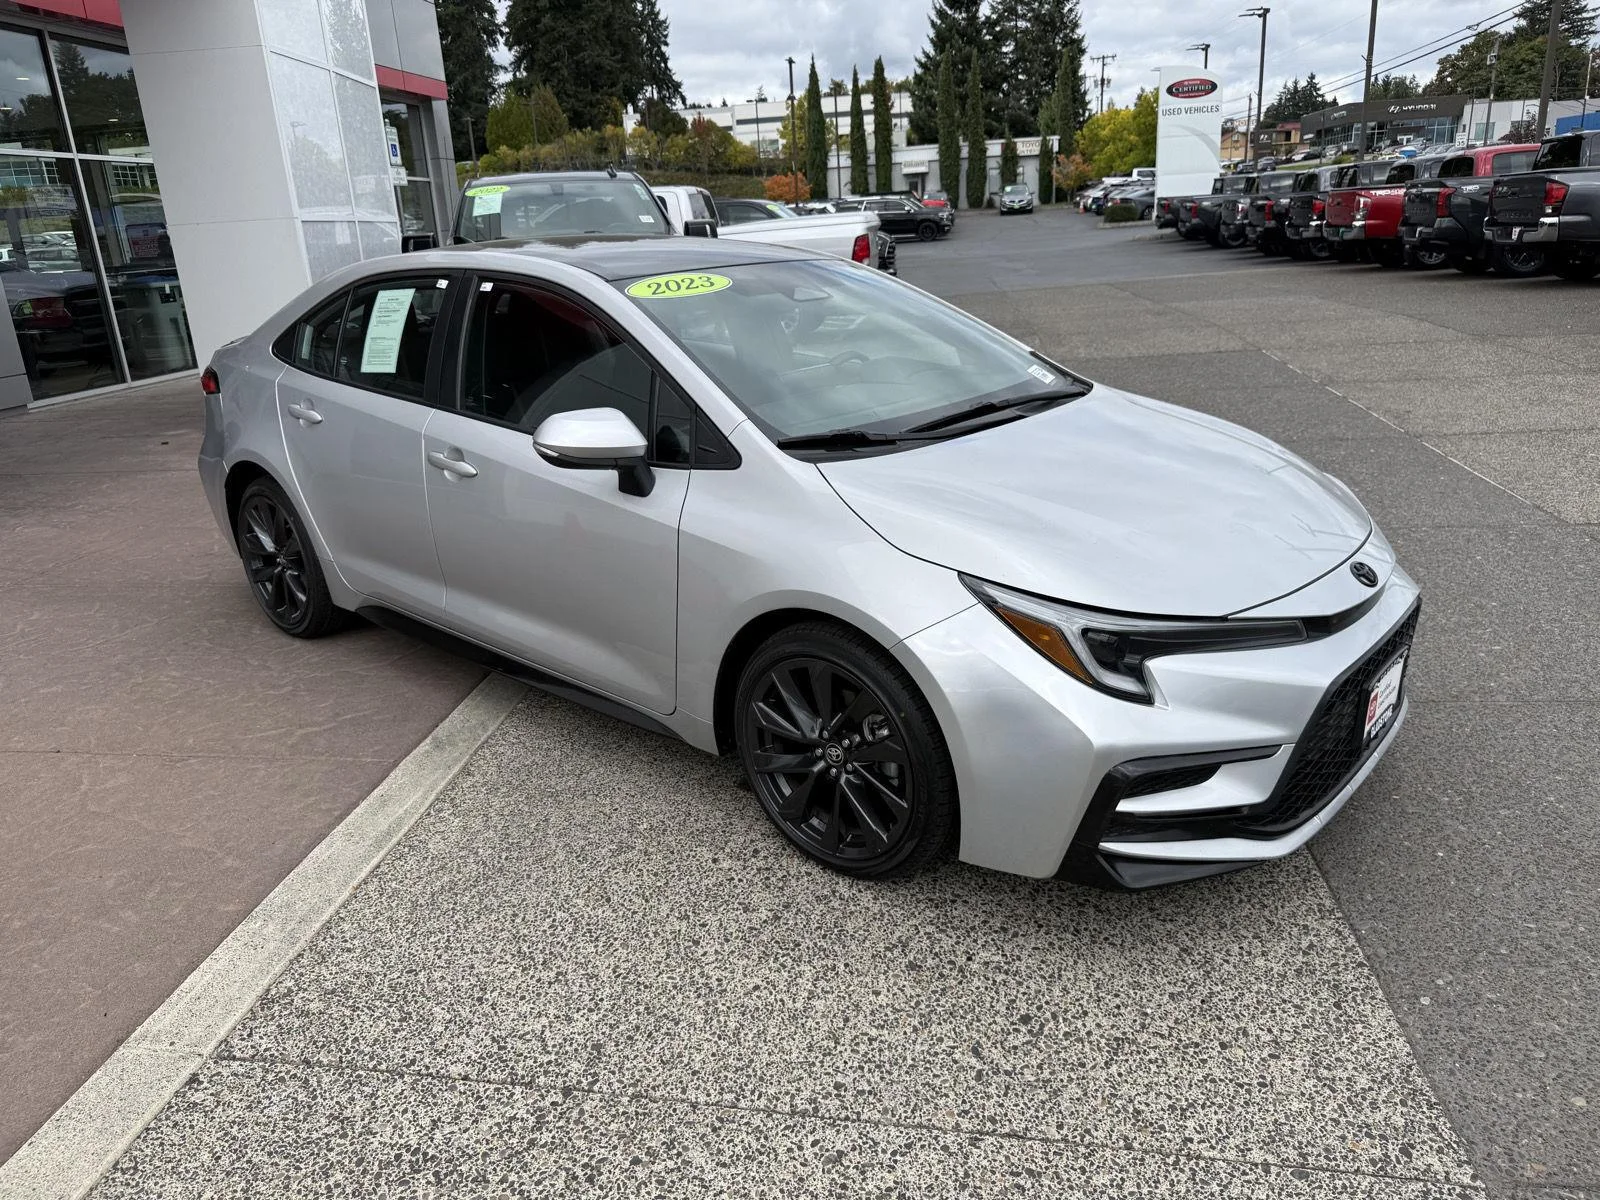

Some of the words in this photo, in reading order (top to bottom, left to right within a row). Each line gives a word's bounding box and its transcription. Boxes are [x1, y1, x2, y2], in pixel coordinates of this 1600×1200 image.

[1161, 107, 1182, 117] USED
[1184, 104, 1220, 115] VEHICLES
[646, 275, 716, 296] 2023
